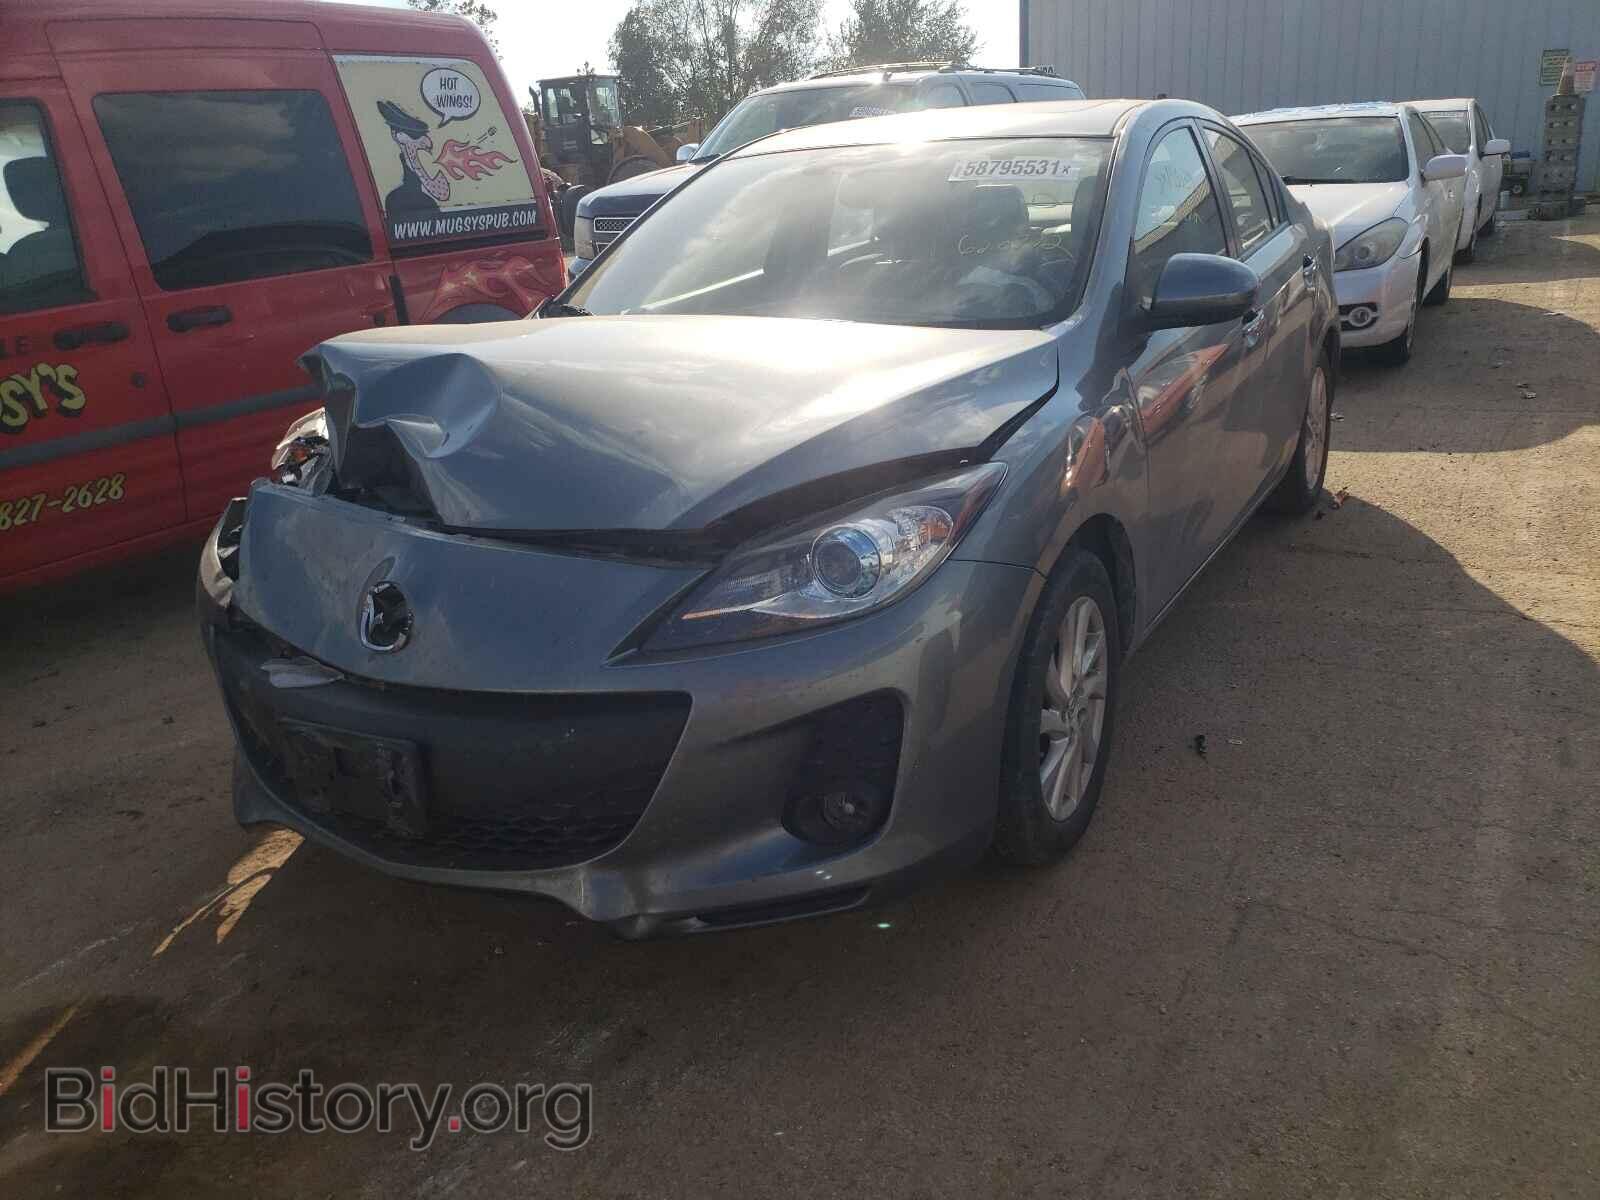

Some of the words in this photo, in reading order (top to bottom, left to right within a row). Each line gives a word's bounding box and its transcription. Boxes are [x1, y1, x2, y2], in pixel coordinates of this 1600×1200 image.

[439, 77, 459, 90] HOT
[437, 94, 473, 108] WINGS!
[393, 210, 537, 240] WWW.MUGSYSPUB.COM
[0, 362, 86, 432] SY'S
[0, 473, 126, 531] 827-2628
